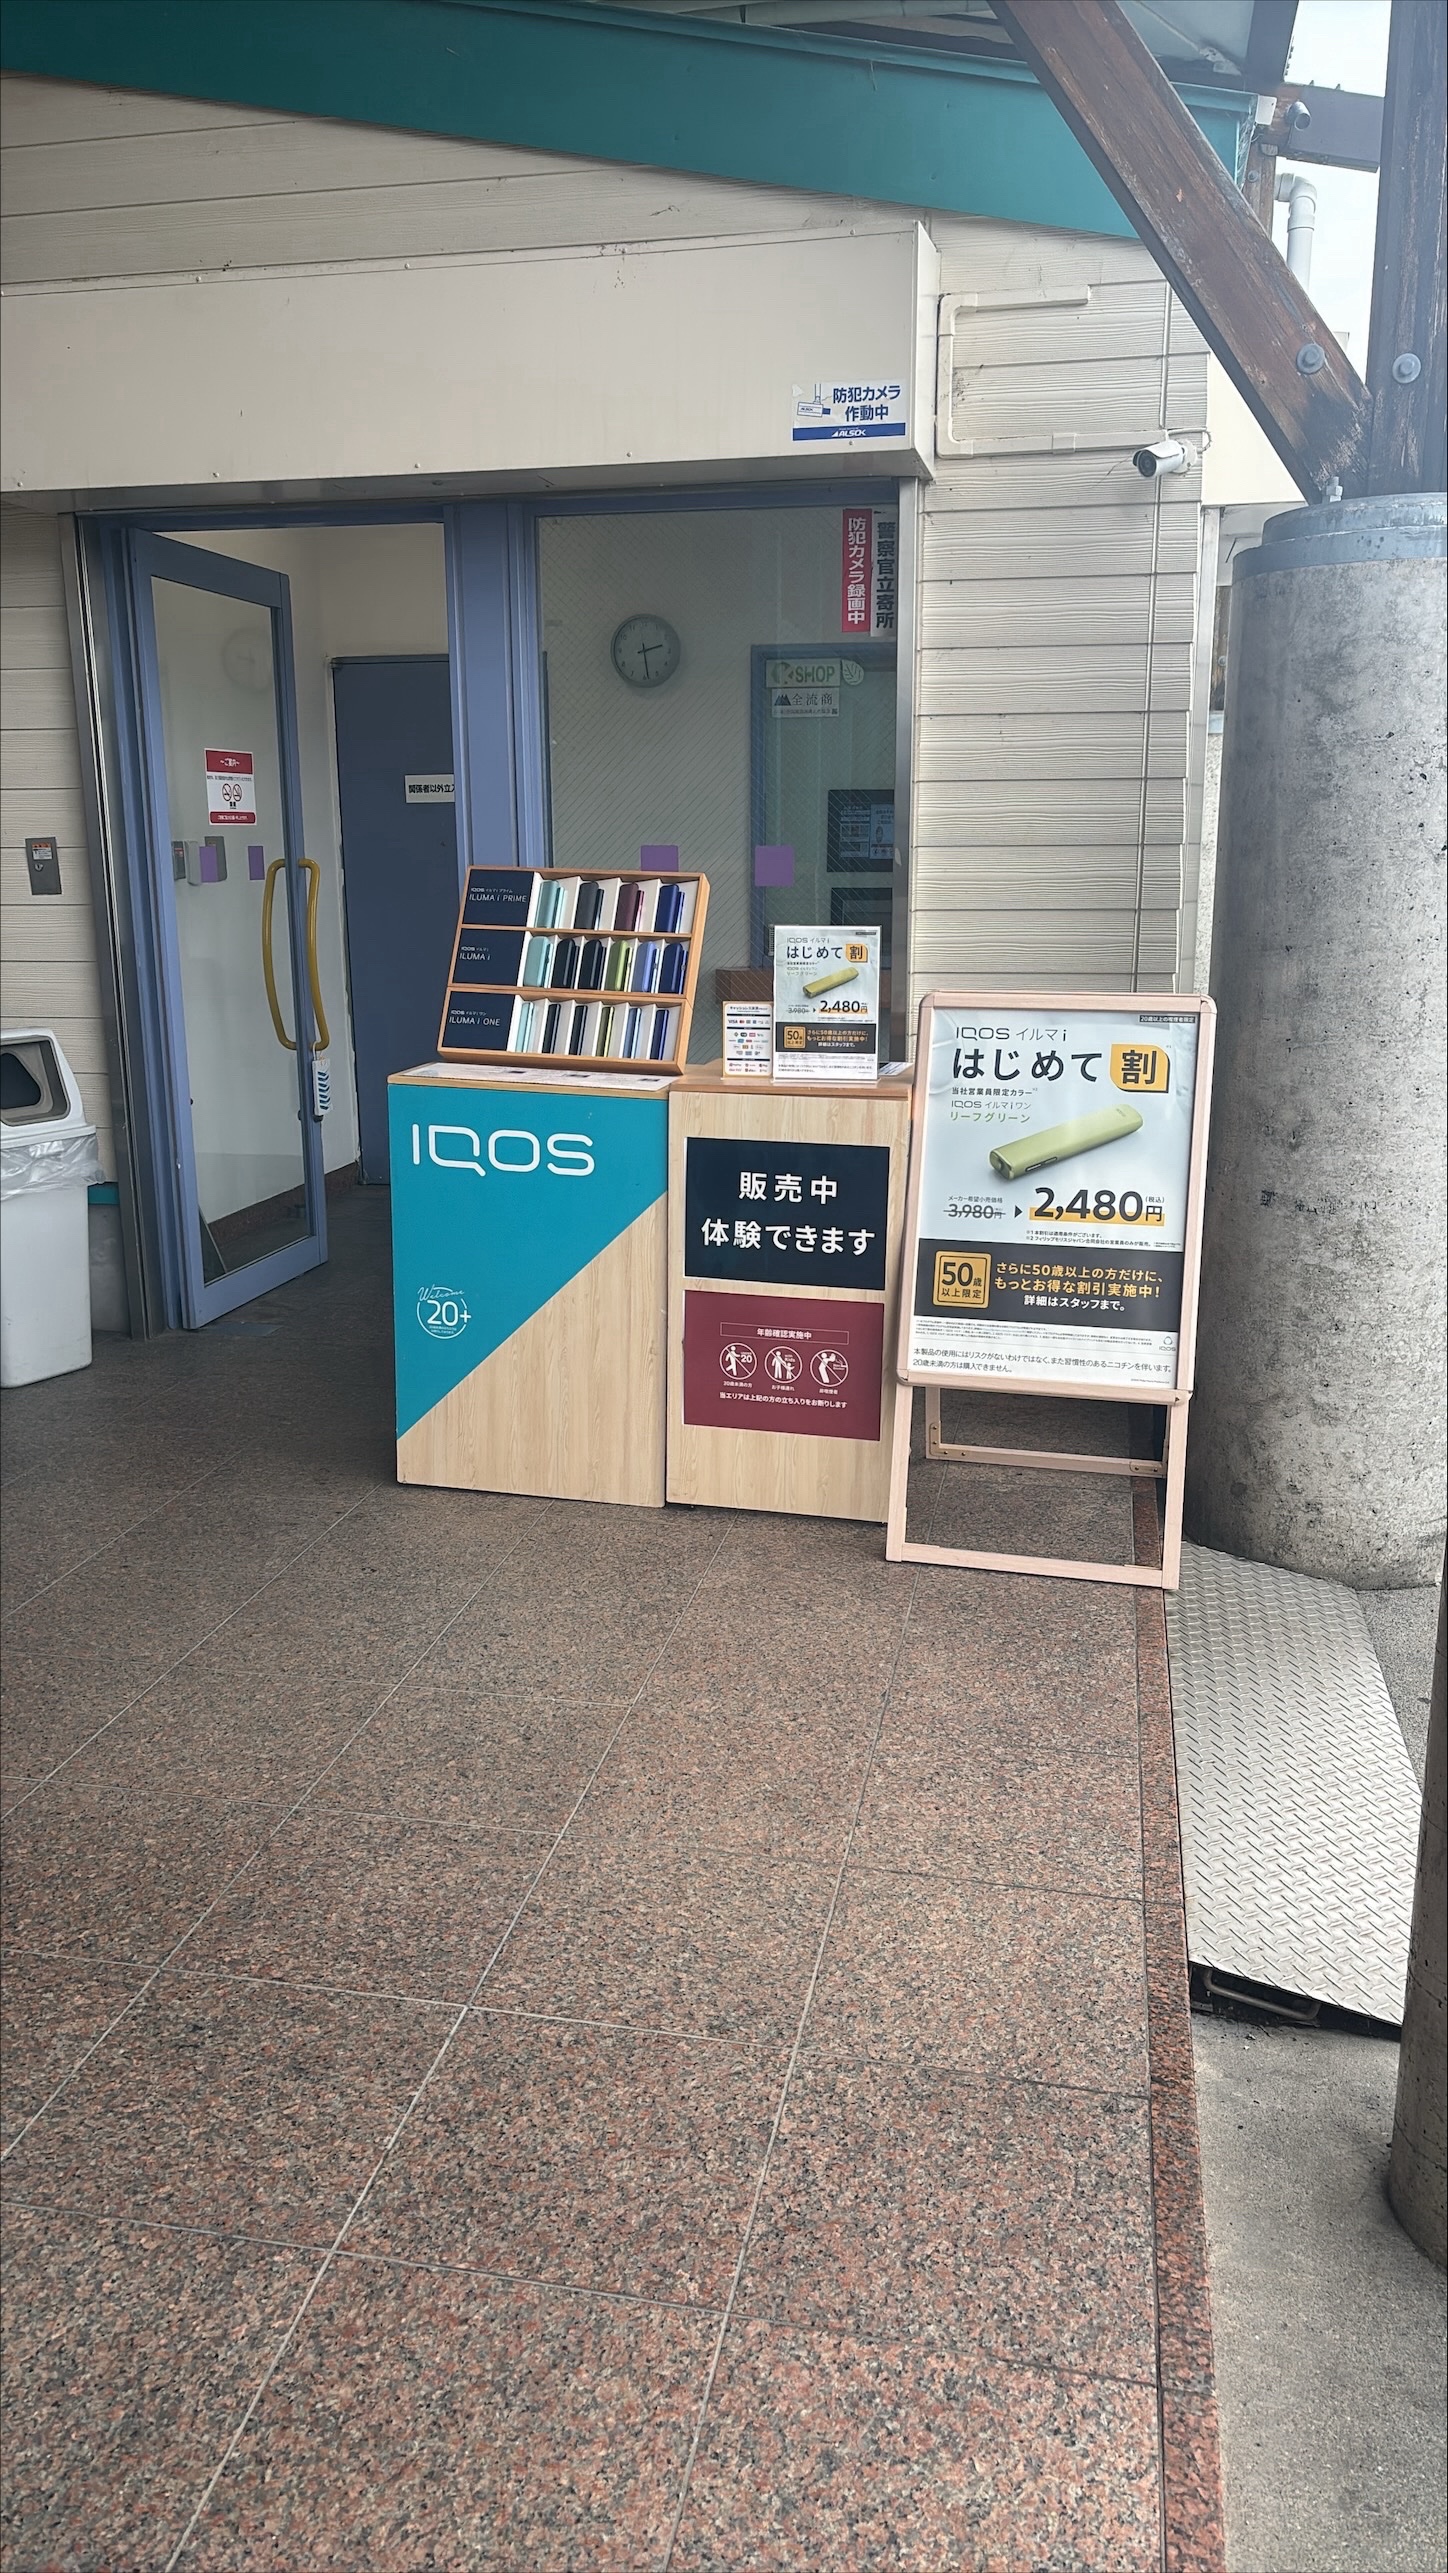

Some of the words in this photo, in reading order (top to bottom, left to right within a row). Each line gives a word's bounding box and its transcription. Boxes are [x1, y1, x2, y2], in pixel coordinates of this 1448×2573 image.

[832, 385, 901, 404] 防犯カメラ
[845, 404, 889, 421] 作動中
[838, 429, 866, 437] ALSOK
[847, 517, 867, 625] 防犯カメラ録画中
[875, 521, 896, 629] 警察官立寄所
[795, 665, 835, 683] SHOP
[502, 894, 528, 903] PRIME
[459, 952, 486, 960] ILUMA
[787, 946, 843, 959] はじめて
[849, 945, 863, 960] 割
[820, 1000, 868, 1014] 2,480円
[449, 1016, 475, 1024] ILUMA
[482, 1017, 501, 1026] ONE
[956, 1027, 1010, 1041] IQOS
[953, 1048, 1102, 1082] はじめて
[1121, 1049, 1157, 1085] 割
[952, 1087, 1033, 1097] 当社営業員限定カラー
[951, 1100, 982, 1109] IQOS
[950, 1111, 1031, 1123] リーフグリーン
[412, 1123, 595, 1177] IQOS
[739, 1171, 838, 1204] 販売中
[701, 1218, 876, 1256] 体験できます
[941, 1262, 983, 1287] 50歳
[996, 1262, 1163, 1283] さらに50歳以上の方だけに、
[417, 1284, 465, 1301] Welcome
[941, 1287, 983, 1299] 以上限定
[995, 1277, 1160, 1299] もっとお得な割引実施中!
[1024, 1295, 1126, 1311] 詳細はスタッフまで。
[427, 1300, 471, 1326] 20+
[757, 1328, 812, 1340] 年齢確認実施中
[740, 1354, 753, 1363] 20
[912, 1358, 1013, 1373] 20歳未満の方は購入できません。
[914, 1348, 1172, 1373] 本製品の使用にはリスクがないわけではなく、また習慣性のあるニコチンを伴います。
[719, 1391, 848, 1409] 当エリアは上記の方の立ち入りをお断りします
